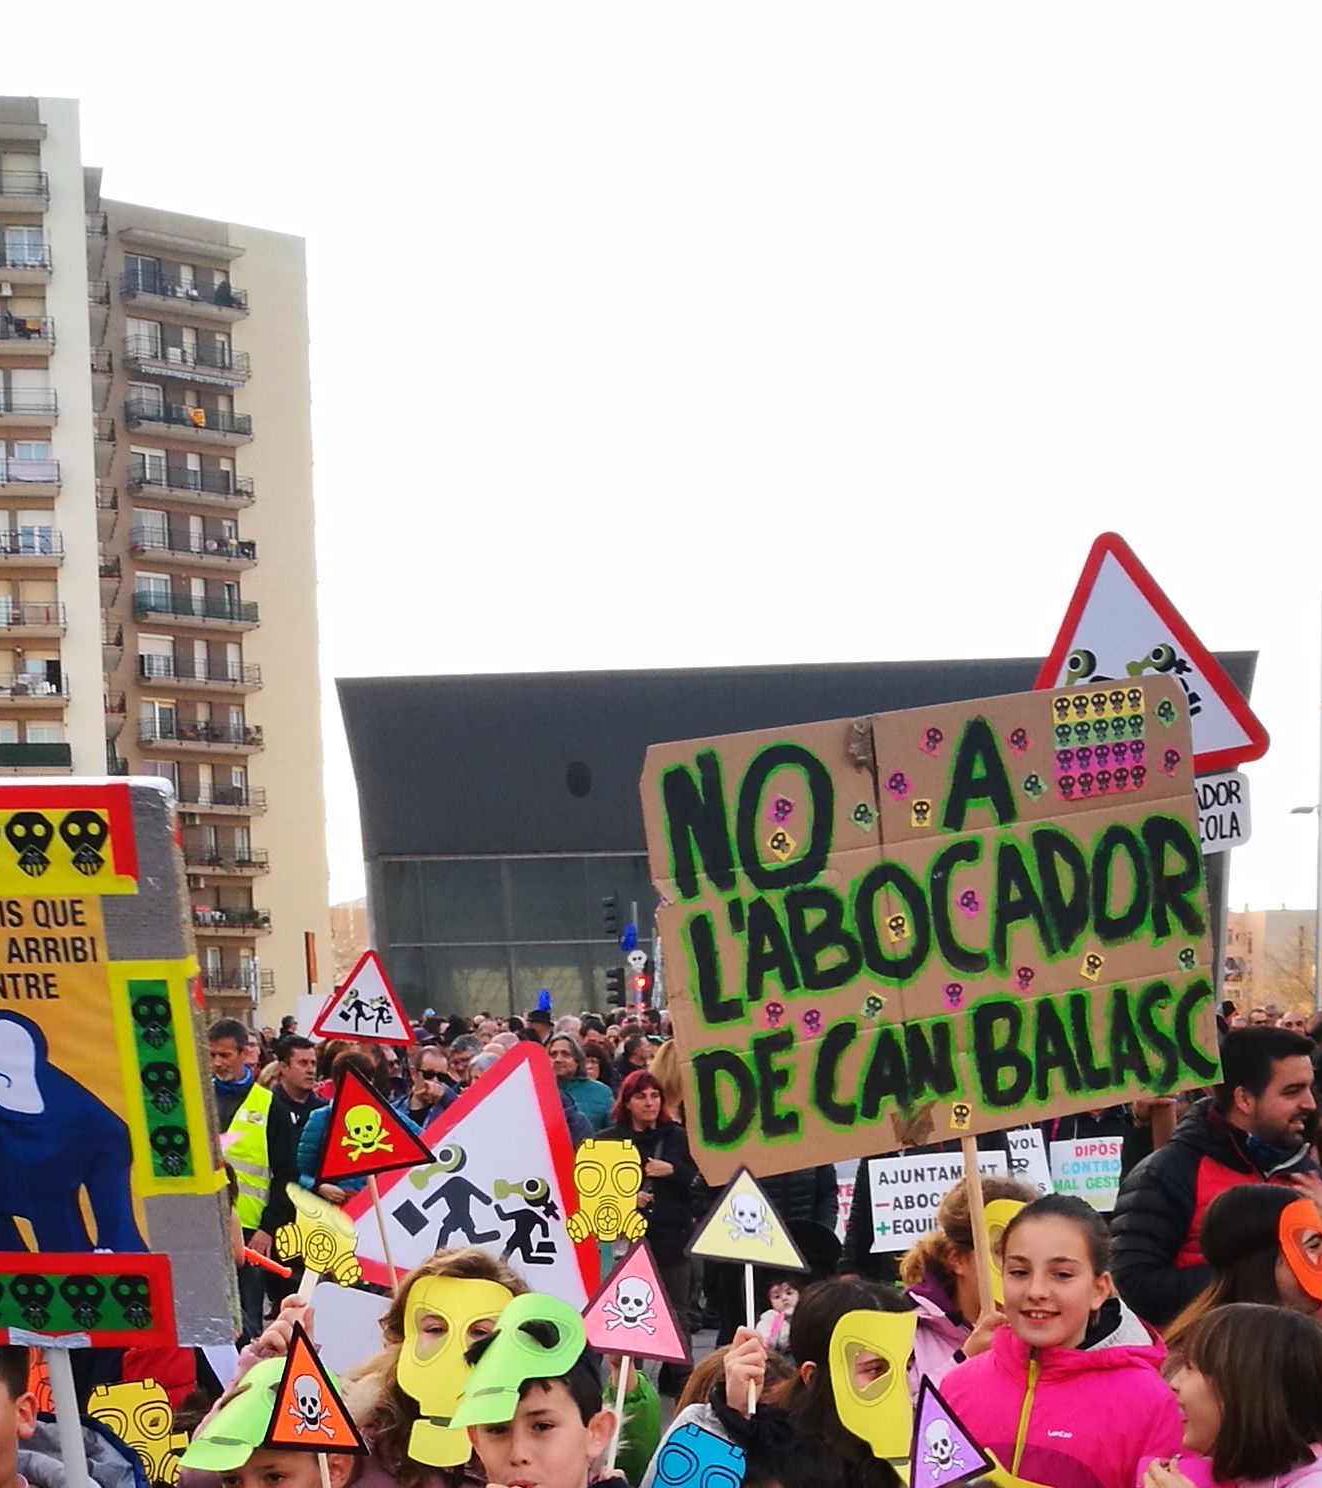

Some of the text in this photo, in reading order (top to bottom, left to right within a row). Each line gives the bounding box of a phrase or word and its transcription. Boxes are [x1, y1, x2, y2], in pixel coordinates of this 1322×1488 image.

[661, 717, 1018, 900] NO A
[7, 935, 97, 964] ARRIBI
[32, 898, 85, 928] QUE
[689, 815, 1207, 1026] L'ABOCADOR
[691, 978, 1220, 1149] DE CAN BALASC
